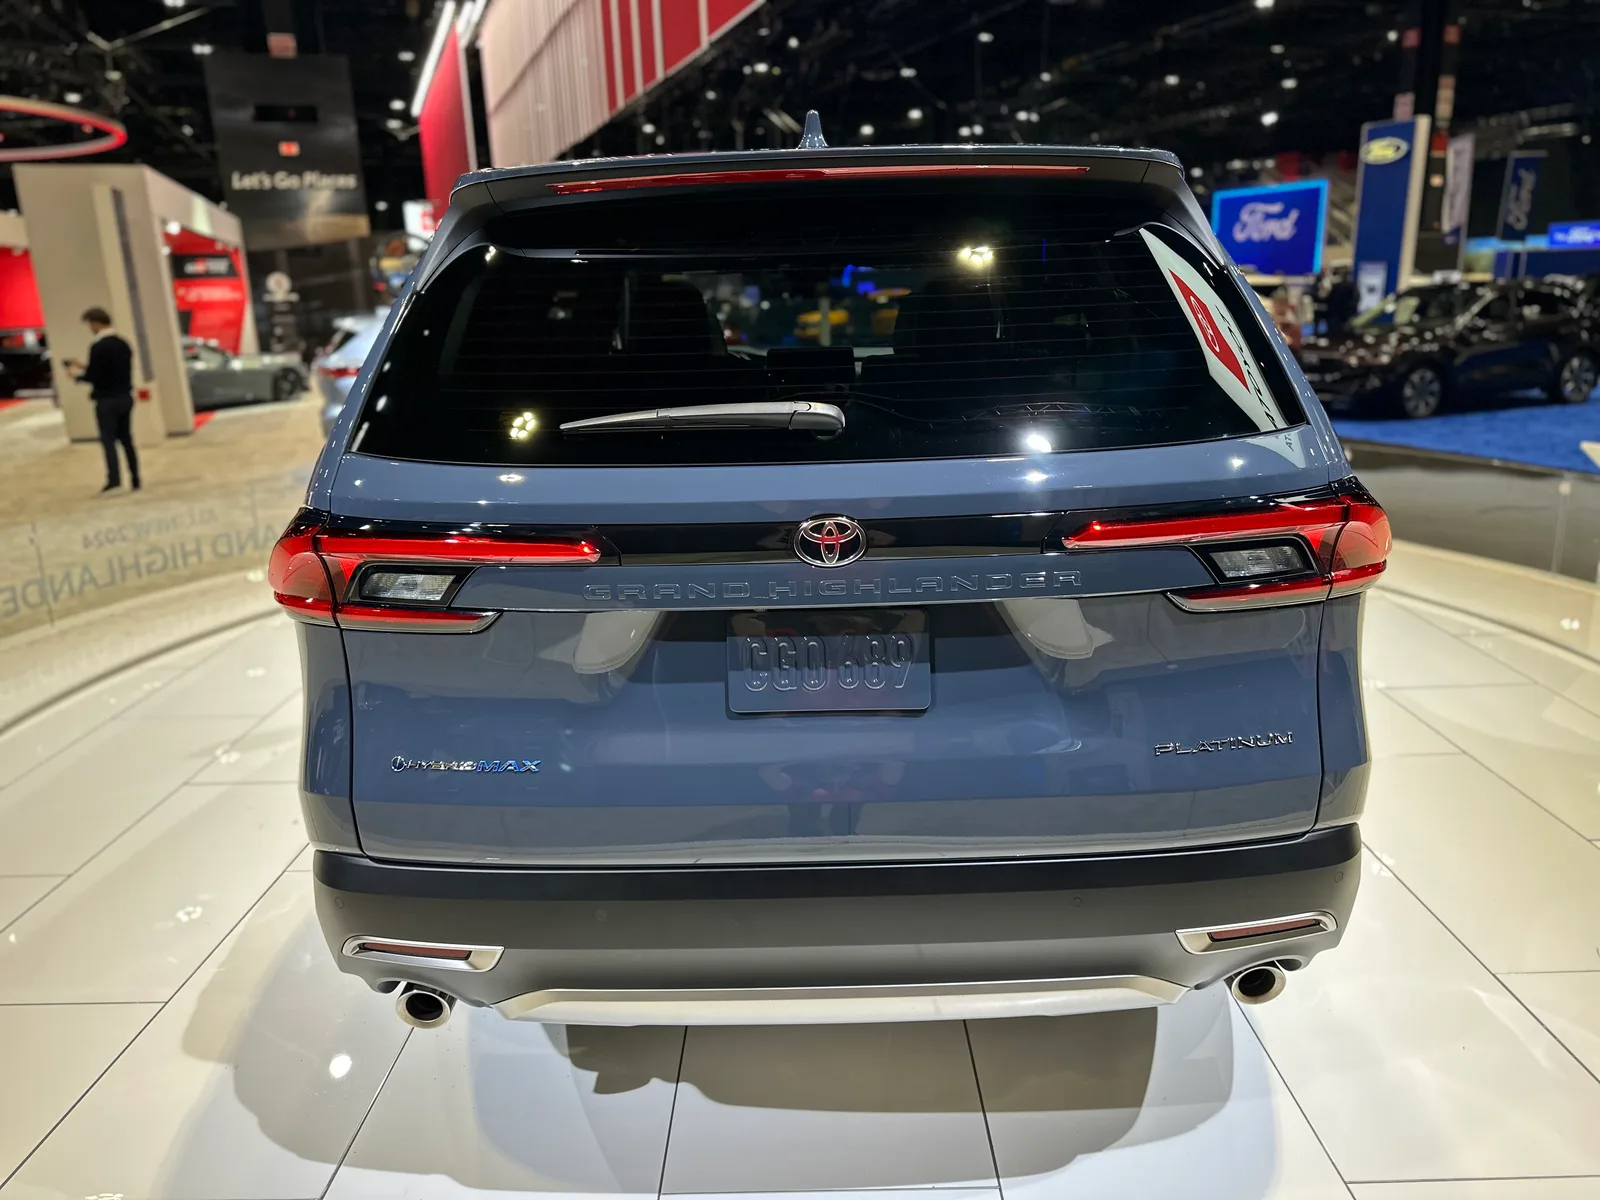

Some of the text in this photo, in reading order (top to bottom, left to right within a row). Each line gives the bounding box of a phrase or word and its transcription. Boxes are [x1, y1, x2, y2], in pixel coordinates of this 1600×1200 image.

[273, 171, 301, 190] Go
[302, 170, 358, 190] Places
[1232, 202, 1300, 243] Ford
[583, 570, 1083, 600] GRAND HIGHLANDER
[836, 632, 914, 690] 689
[1154, 731, 1294, 756] PLATINUM
